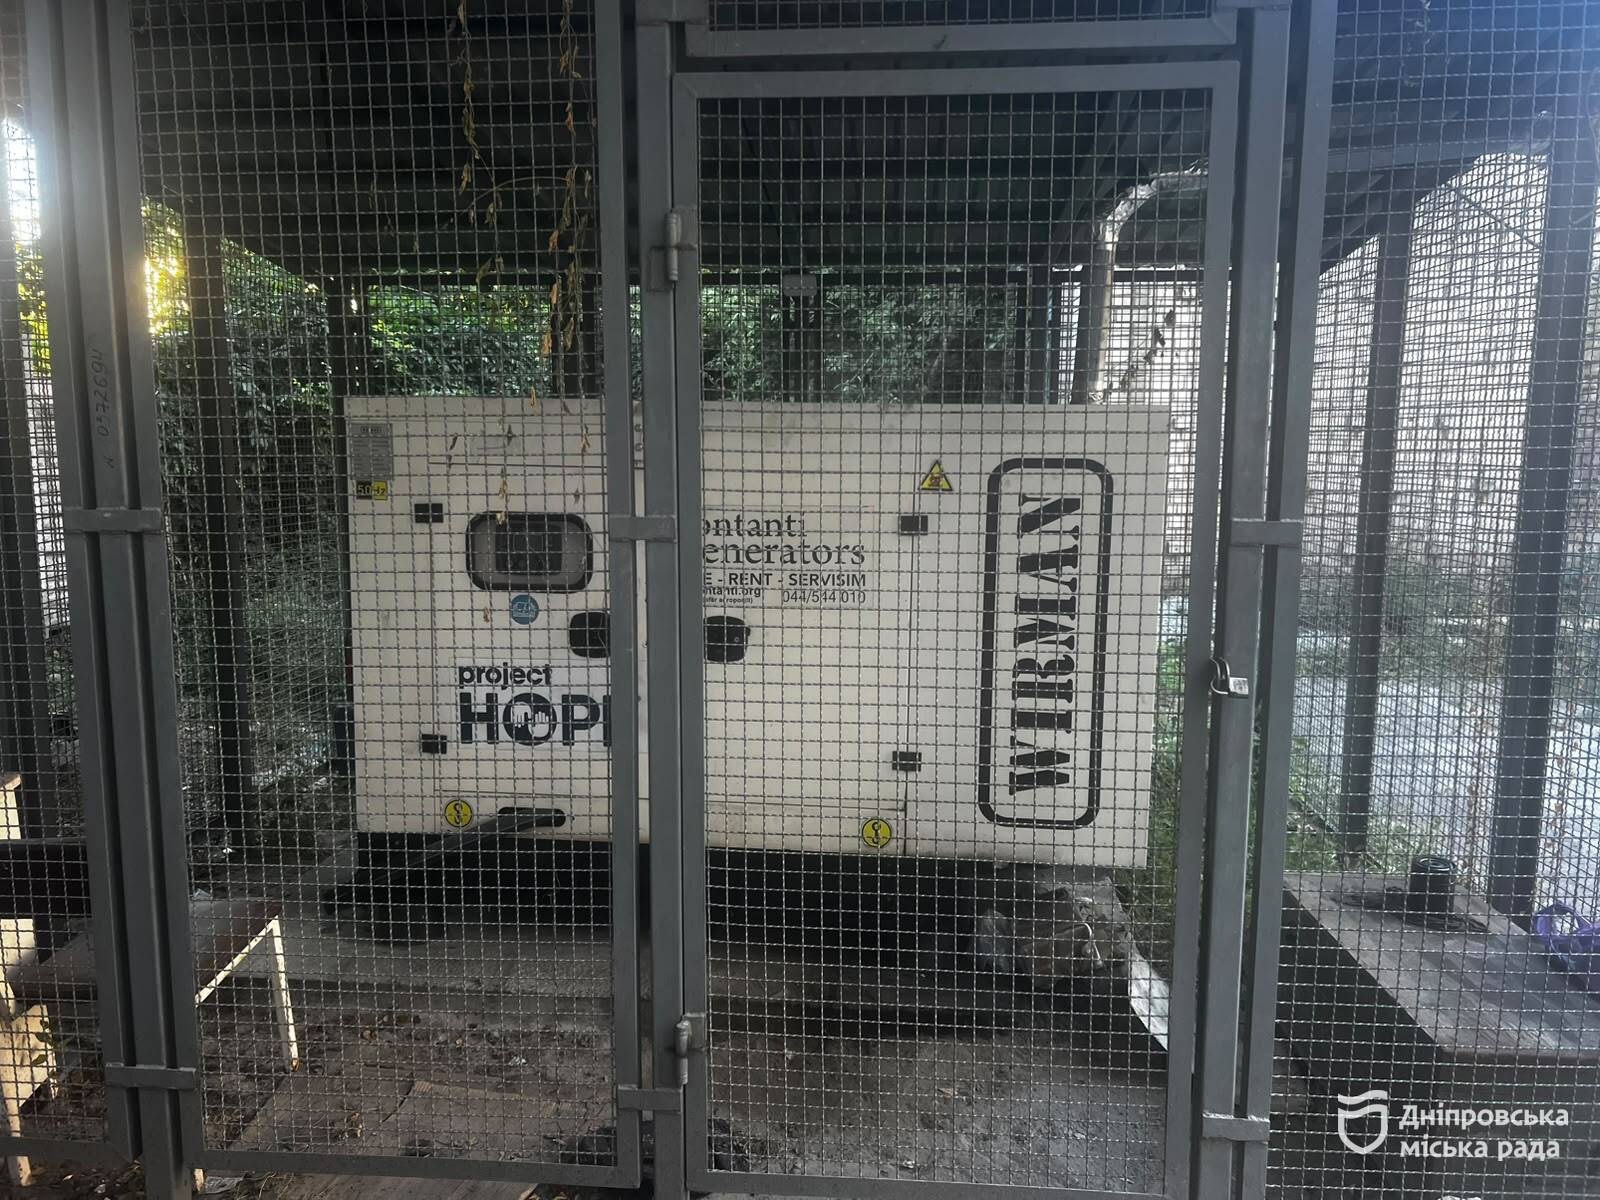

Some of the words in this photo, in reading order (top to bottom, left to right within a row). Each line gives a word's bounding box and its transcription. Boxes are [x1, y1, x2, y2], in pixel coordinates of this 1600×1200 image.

[702, 511, 808, 537] ntanti
[702, 539, 865, 565] enerators
[703, 586, 761, 597] ntanti.org
[728, 572, 773, 586] RENT
[788, 573, 866, 587] SERVISIM
[841, 590, 866, 603] 010
[1009, 492, 1081, 796] WIRMAN
[458, 662, 552, 690] project
